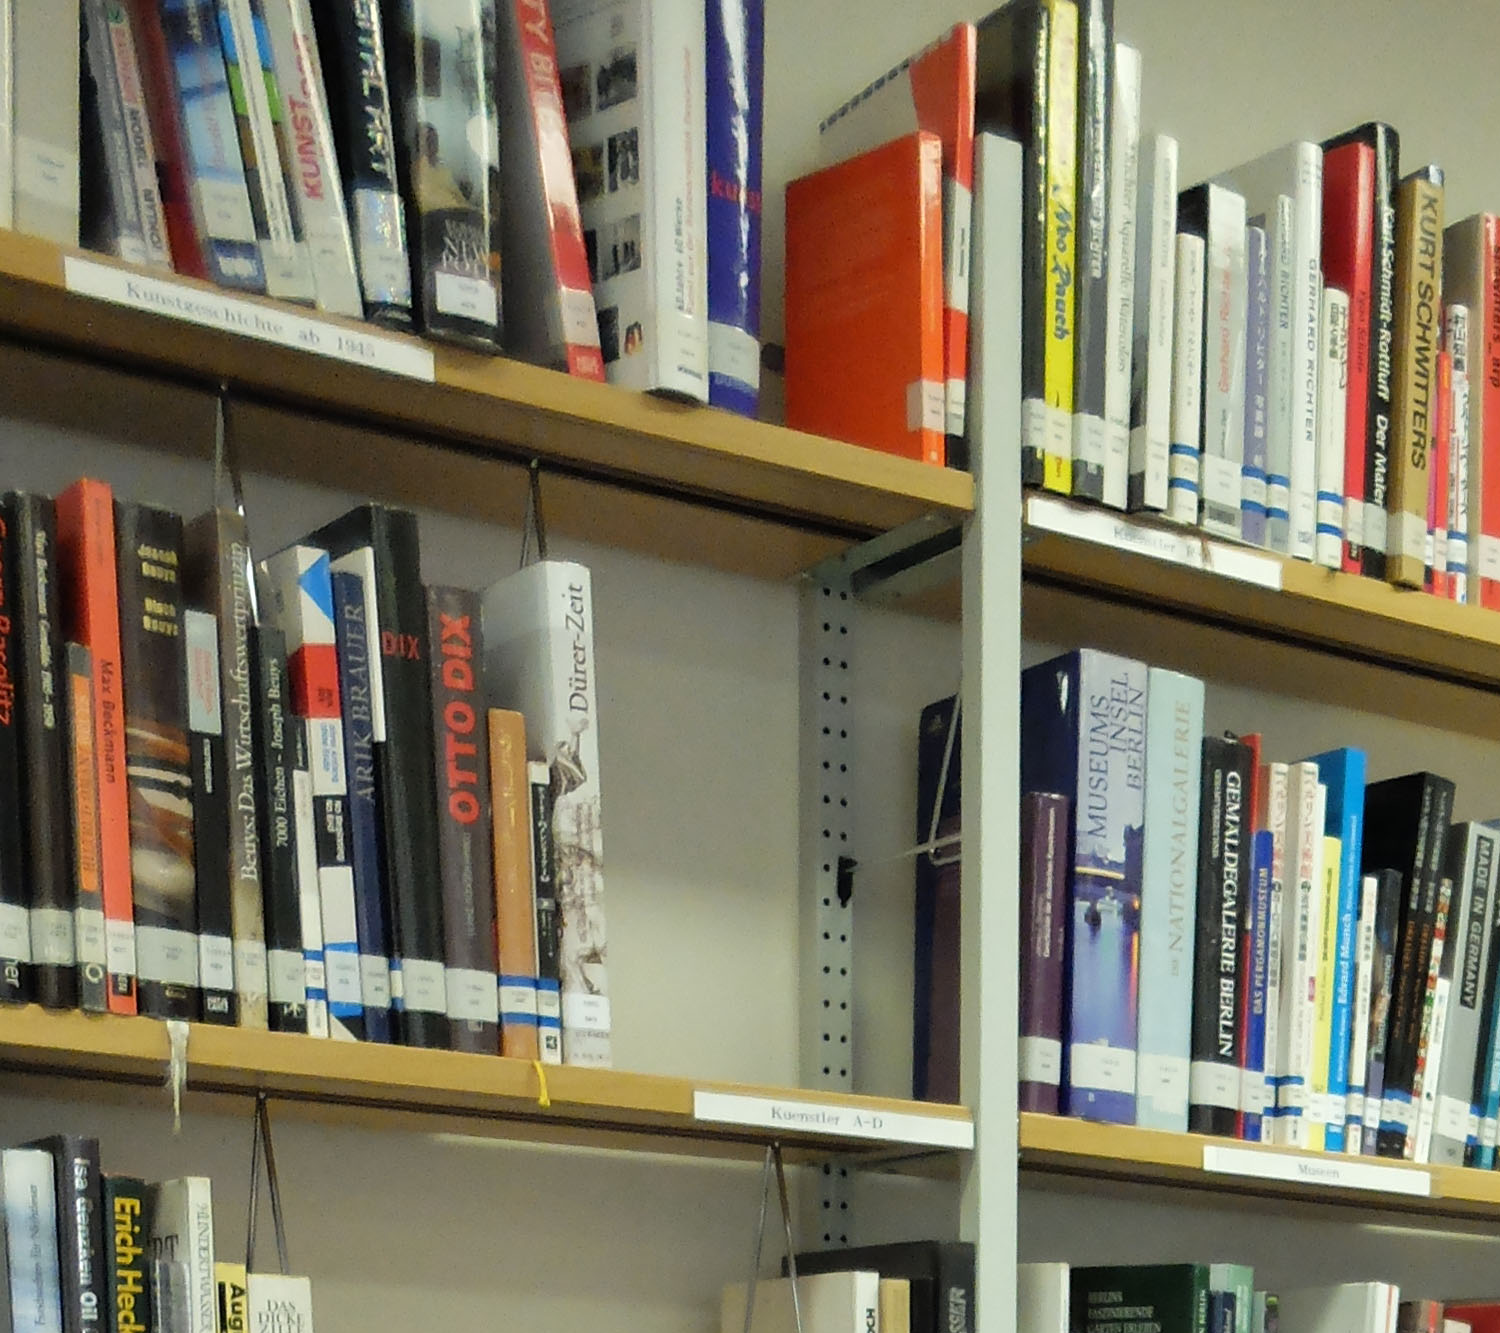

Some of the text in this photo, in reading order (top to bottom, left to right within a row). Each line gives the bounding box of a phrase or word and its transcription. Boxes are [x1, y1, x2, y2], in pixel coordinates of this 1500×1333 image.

[288, 94, 323, 200] KUNST
[126, 282, 376, 363] Kunstgeschichte ab 1945
[1305, 257, 1319, 442] GERHARD RICHTER
[1376, 248, 1394, 401] Schmidt-Rottluff
[1410, 193, 1440, 472] KURT SCHWITTERS
[1374, 414, 1389, 450] Der
[1372, 451, 1388, 505] Maler
[383, 632, 420, 660] DIX
[439, 611, 475, 692] DIX
[561, 581, 589, 713] Dürer-Zeit
[100, 658, 118, 783] Max Beckmann
[344, 602, 375, 801] ARIK BRAUER
[1109, 672, 1129, 753] INSEL
[1125, 686, 1144, 791] BERLIN
[238, 774, 257, 811] Das
[267, 657, 289, 848] 7000 Eichen Joseph Beuys
[443, 700, 480, 824] OTTO
[1086, 694, 1110, 839] MUSEUMS
[239, 814, 261, 880] Beuys:
[1167, 699, 1191, 952] NATIONALGALERIE
[1252, 867, 1269, 1015] DAS PERGAMONMUSEUM
[1339, 913, 1352, 959] Munch
[1463, 838, 1491, 1008] MADE IN GERMANY
[1218, 977, 1236, 1058] BERLIN
[1337, 960, 1350, 1005] Edvard
[771, 1106, 884, 1131] Kuenstler A-D
[73, 1156, 93, 1191] Isa
[75, 1196, 96, 1286] Genzken
[113, 1196, 144, 1265] Erich
[80, 1290, 99, 1322] Oil
[266, 1299, 297, 1313] DAS
